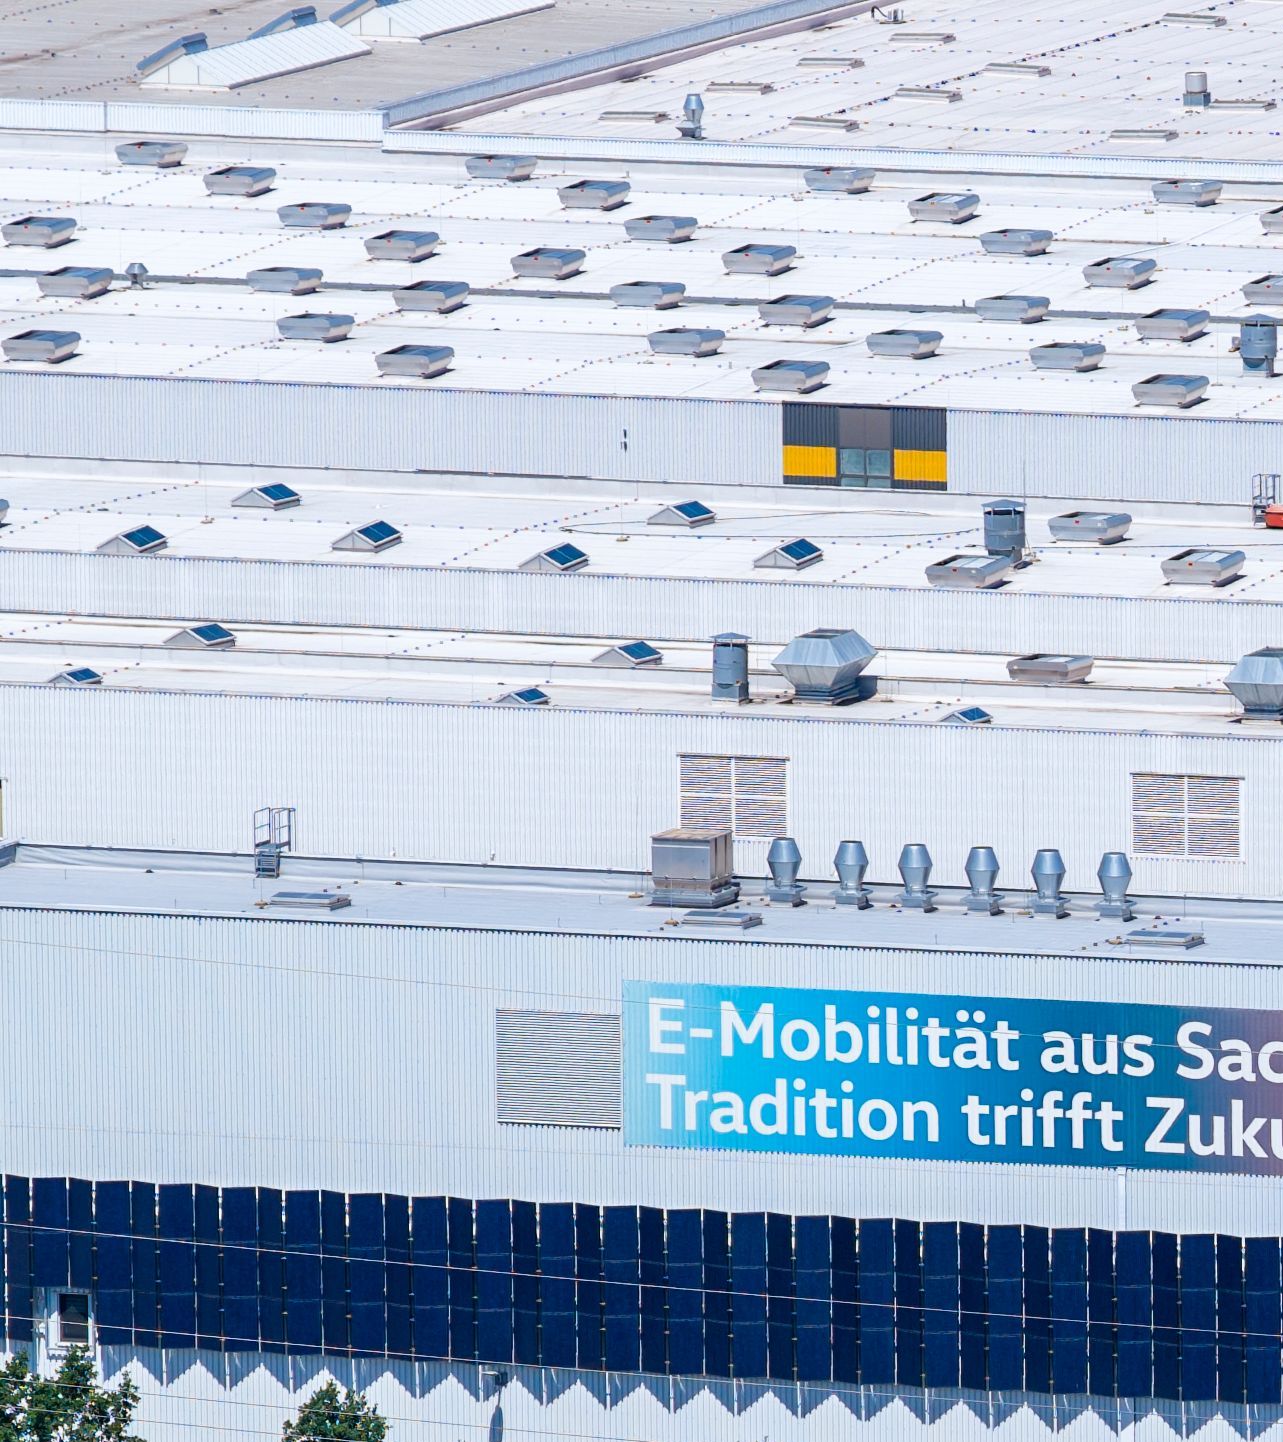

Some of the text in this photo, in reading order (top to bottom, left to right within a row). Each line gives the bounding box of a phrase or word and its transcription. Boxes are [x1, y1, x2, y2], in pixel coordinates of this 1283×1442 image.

[648, 996, 1019, 1072] E-Mobilität
[1040, 1031, 1155, 1077] aus
[644, 1072, 939, 1142] Tradition
[961, 1088, 1124, 1151] trifft
